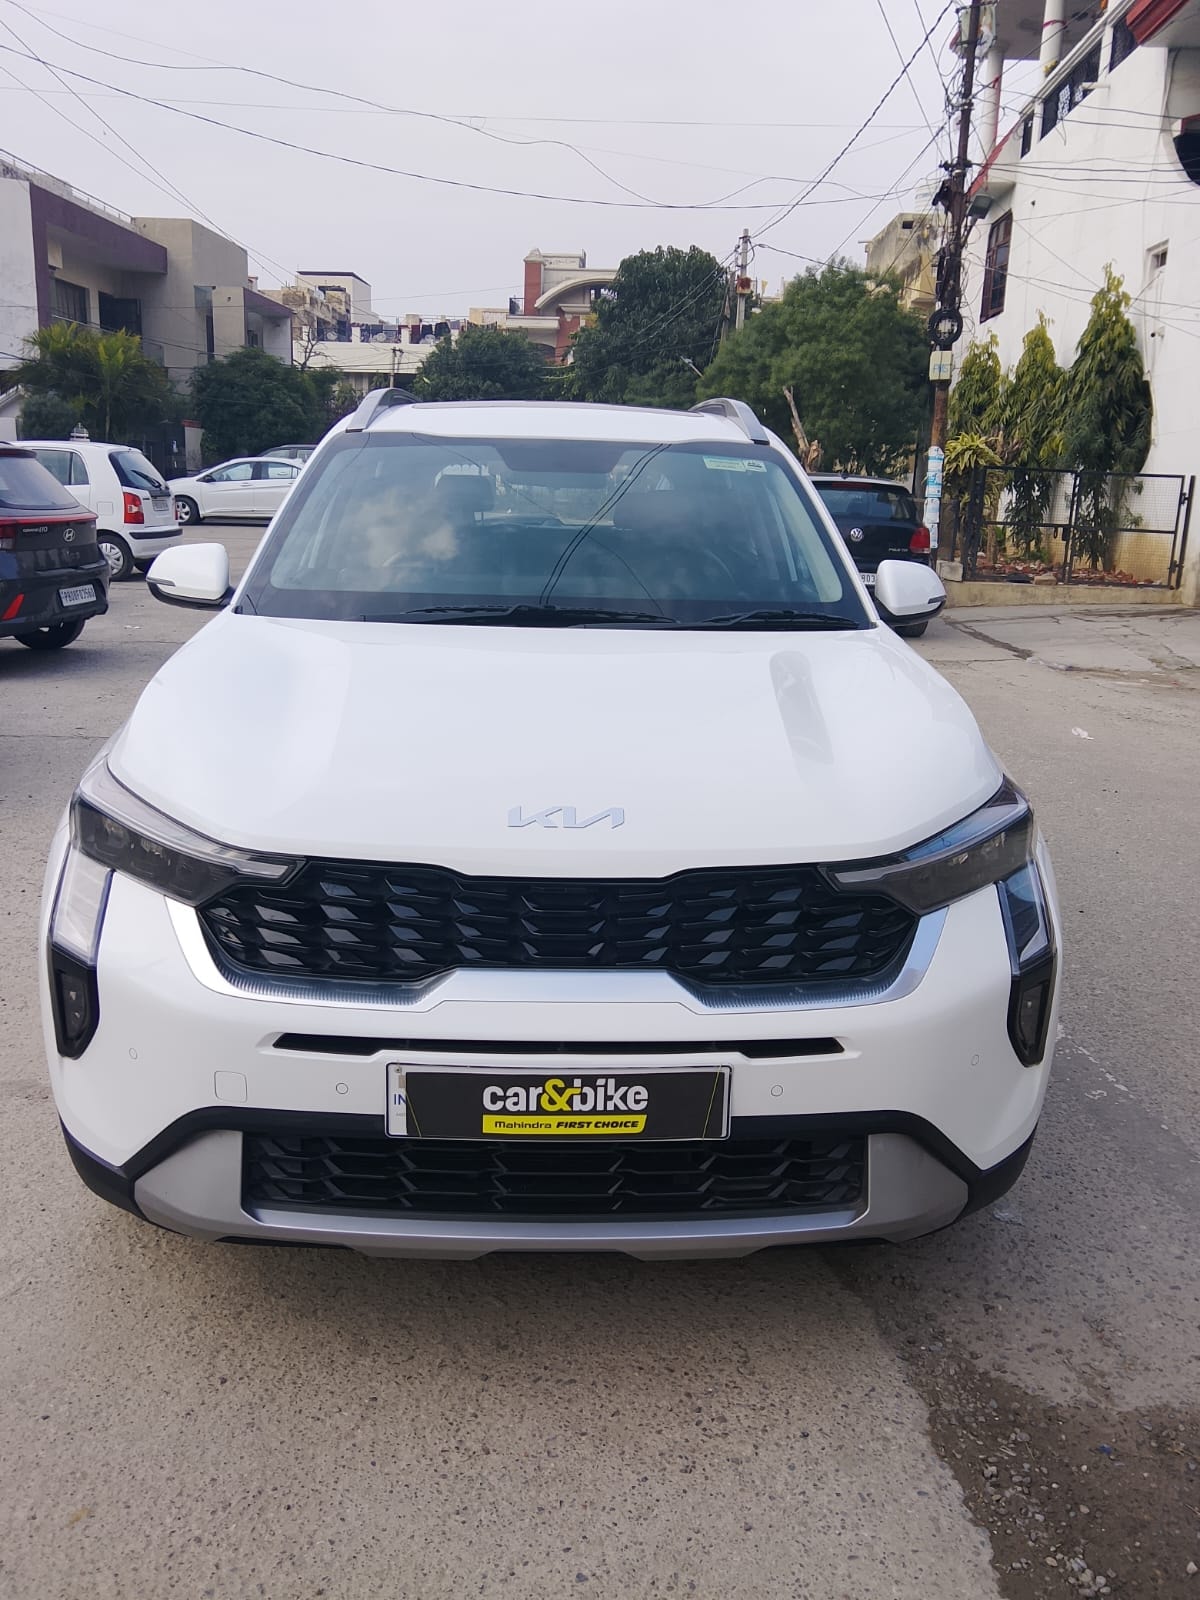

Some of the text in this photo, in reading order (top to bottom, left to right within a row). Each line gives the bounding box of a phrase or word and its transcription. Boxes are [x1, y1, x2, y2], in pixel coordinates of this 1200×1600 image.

[507, 805, 625, 829] KIA
[482, 1078, 649, 1112] car&bike
[494, 1120, 640, 1129] Mahindra FIRST CHOICE
